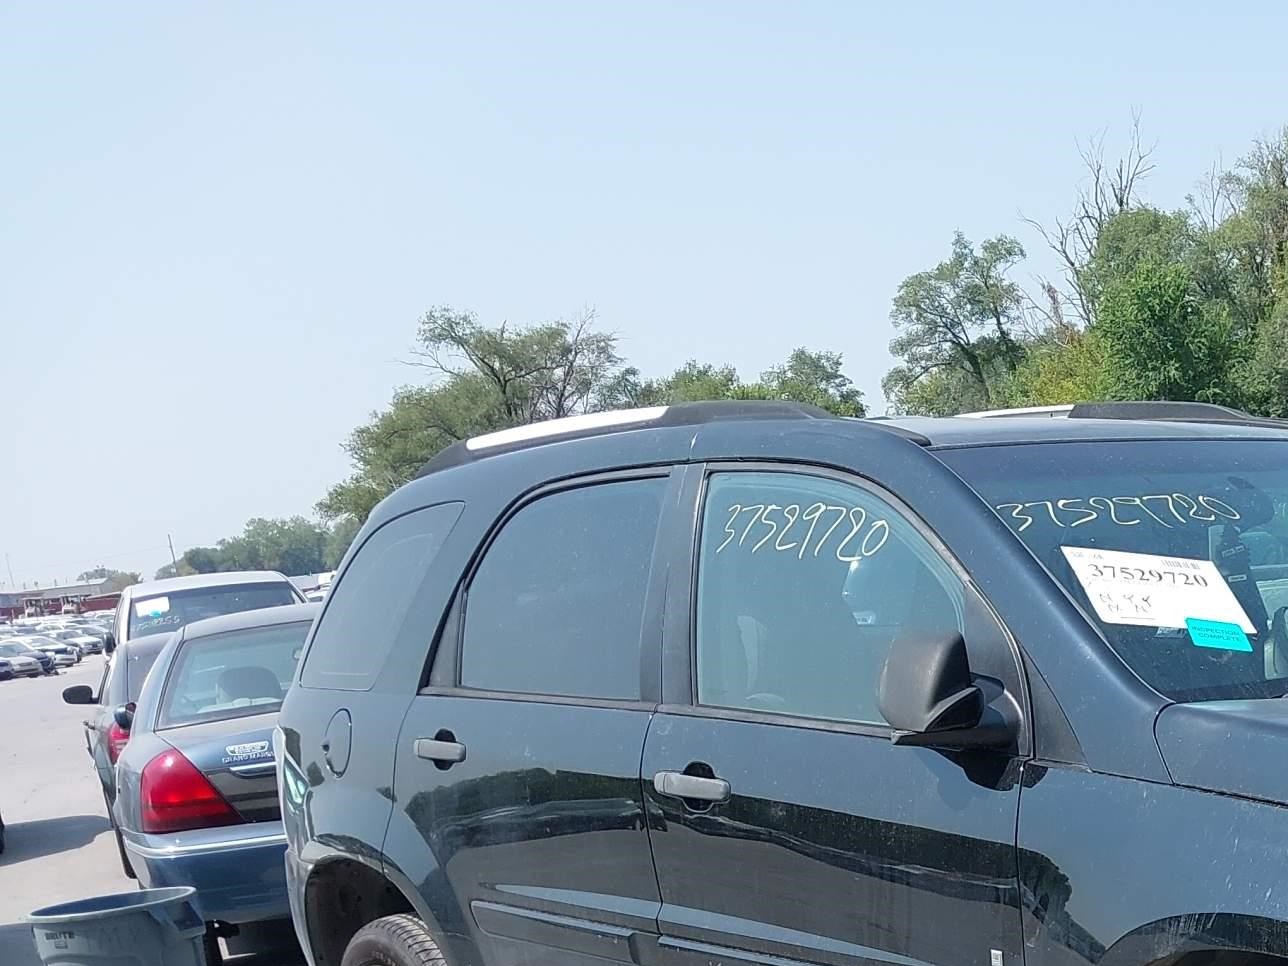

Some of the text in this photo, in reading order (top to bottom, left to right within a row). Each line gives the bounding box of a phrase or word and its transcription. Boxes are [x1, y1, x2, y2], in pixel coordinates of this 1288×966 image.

[996, 493, 1241, 532] 37529720
[716, 503, 889, 562] 37529720
[1088, 563, 1208, 588] 37529720
